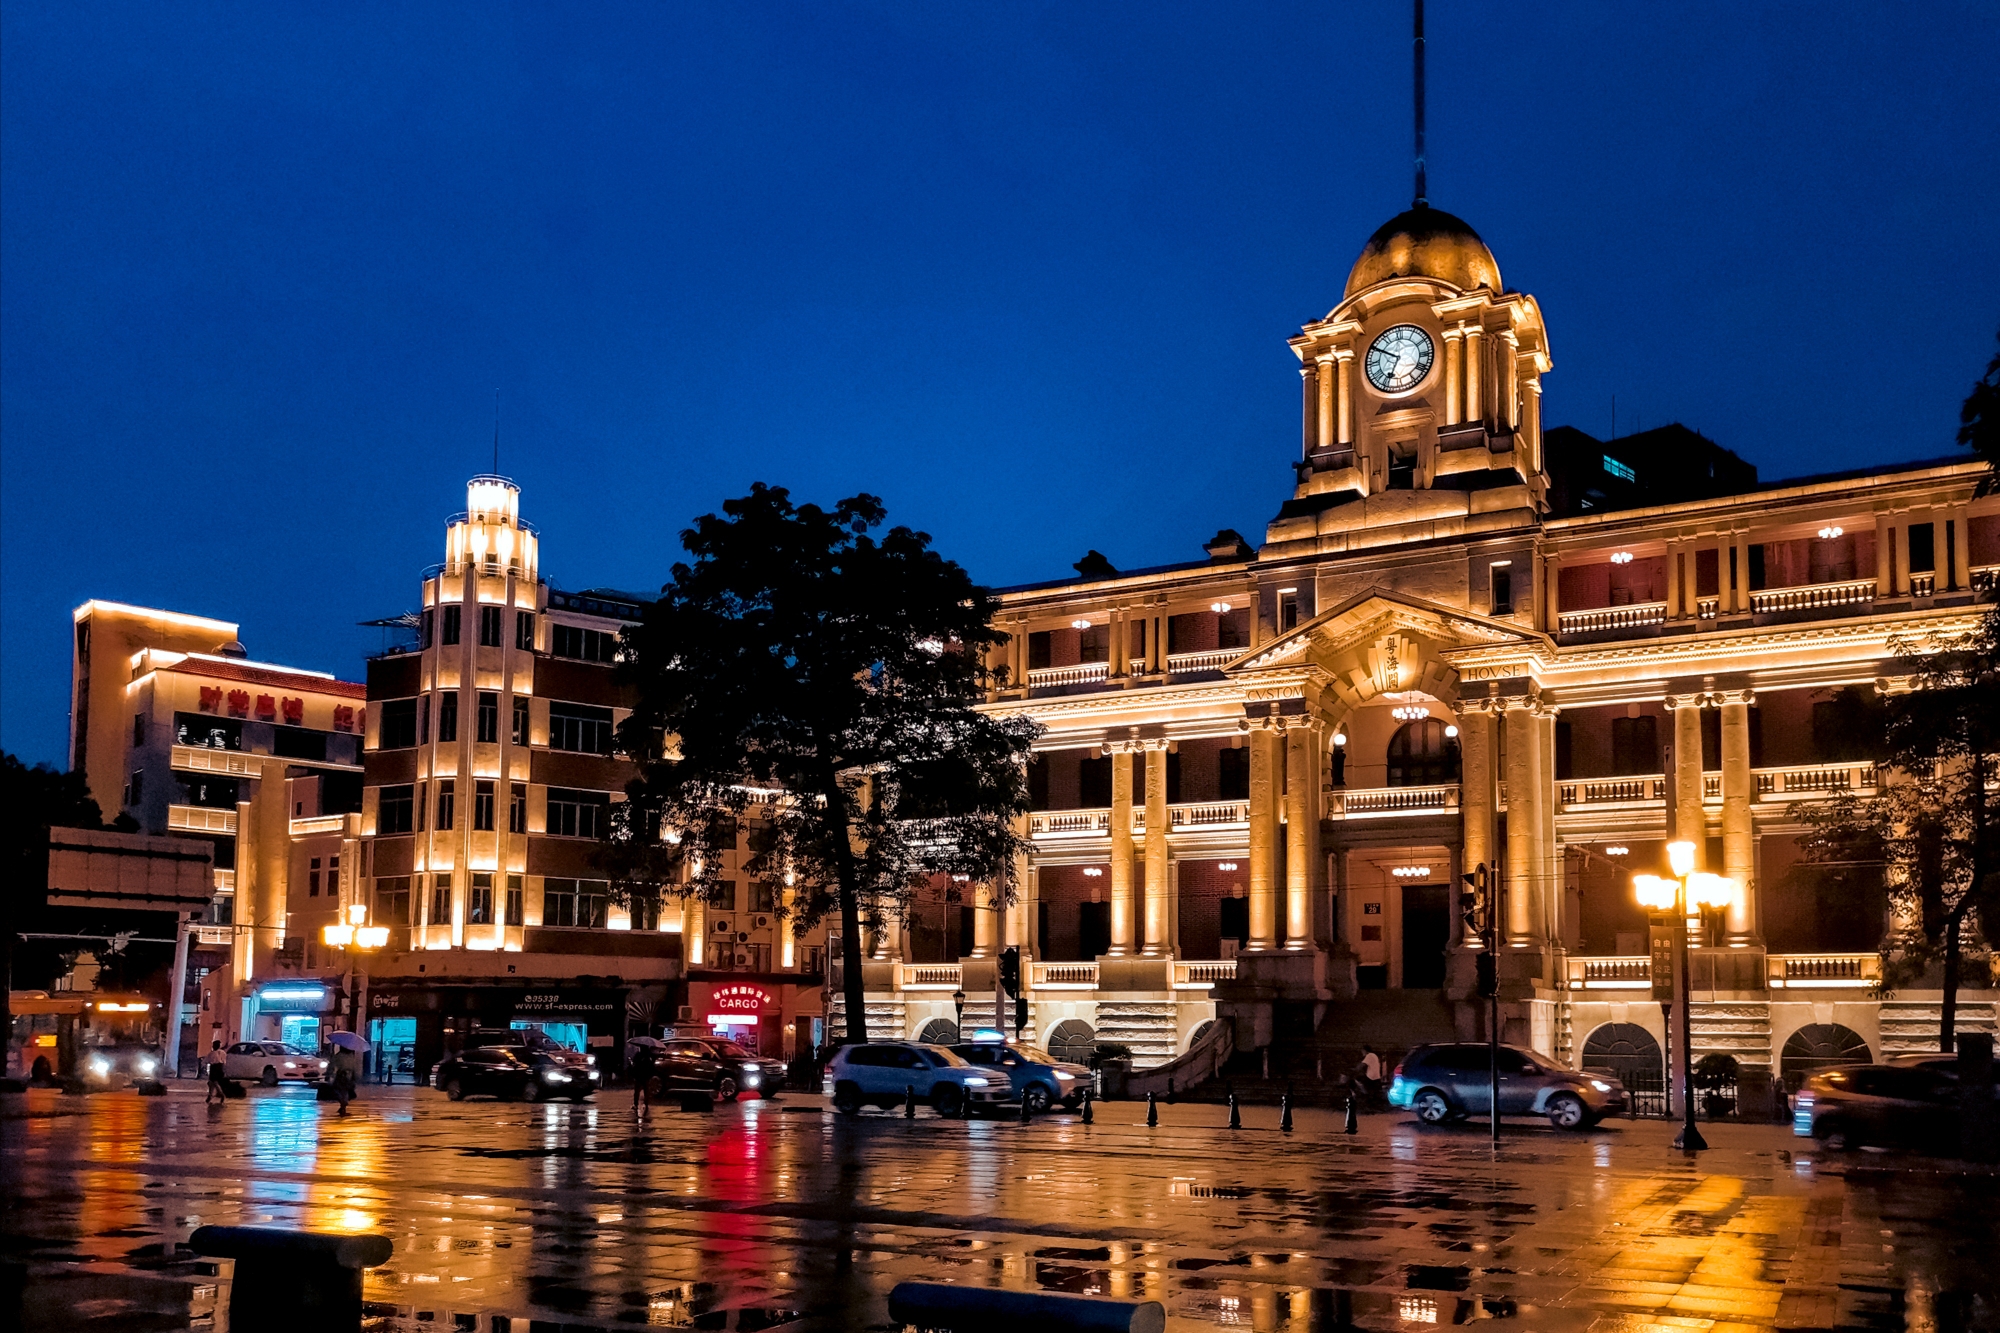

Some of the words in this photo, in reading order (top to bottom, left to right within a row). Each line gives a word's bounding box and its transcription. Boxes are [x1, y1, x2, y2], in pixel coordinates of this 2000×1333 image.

[1468, 664, 1521, 681] HOVSE
[1247, 686, 1304, 701] CVSTOM
[719, 998, 759, 1009] CARGO
